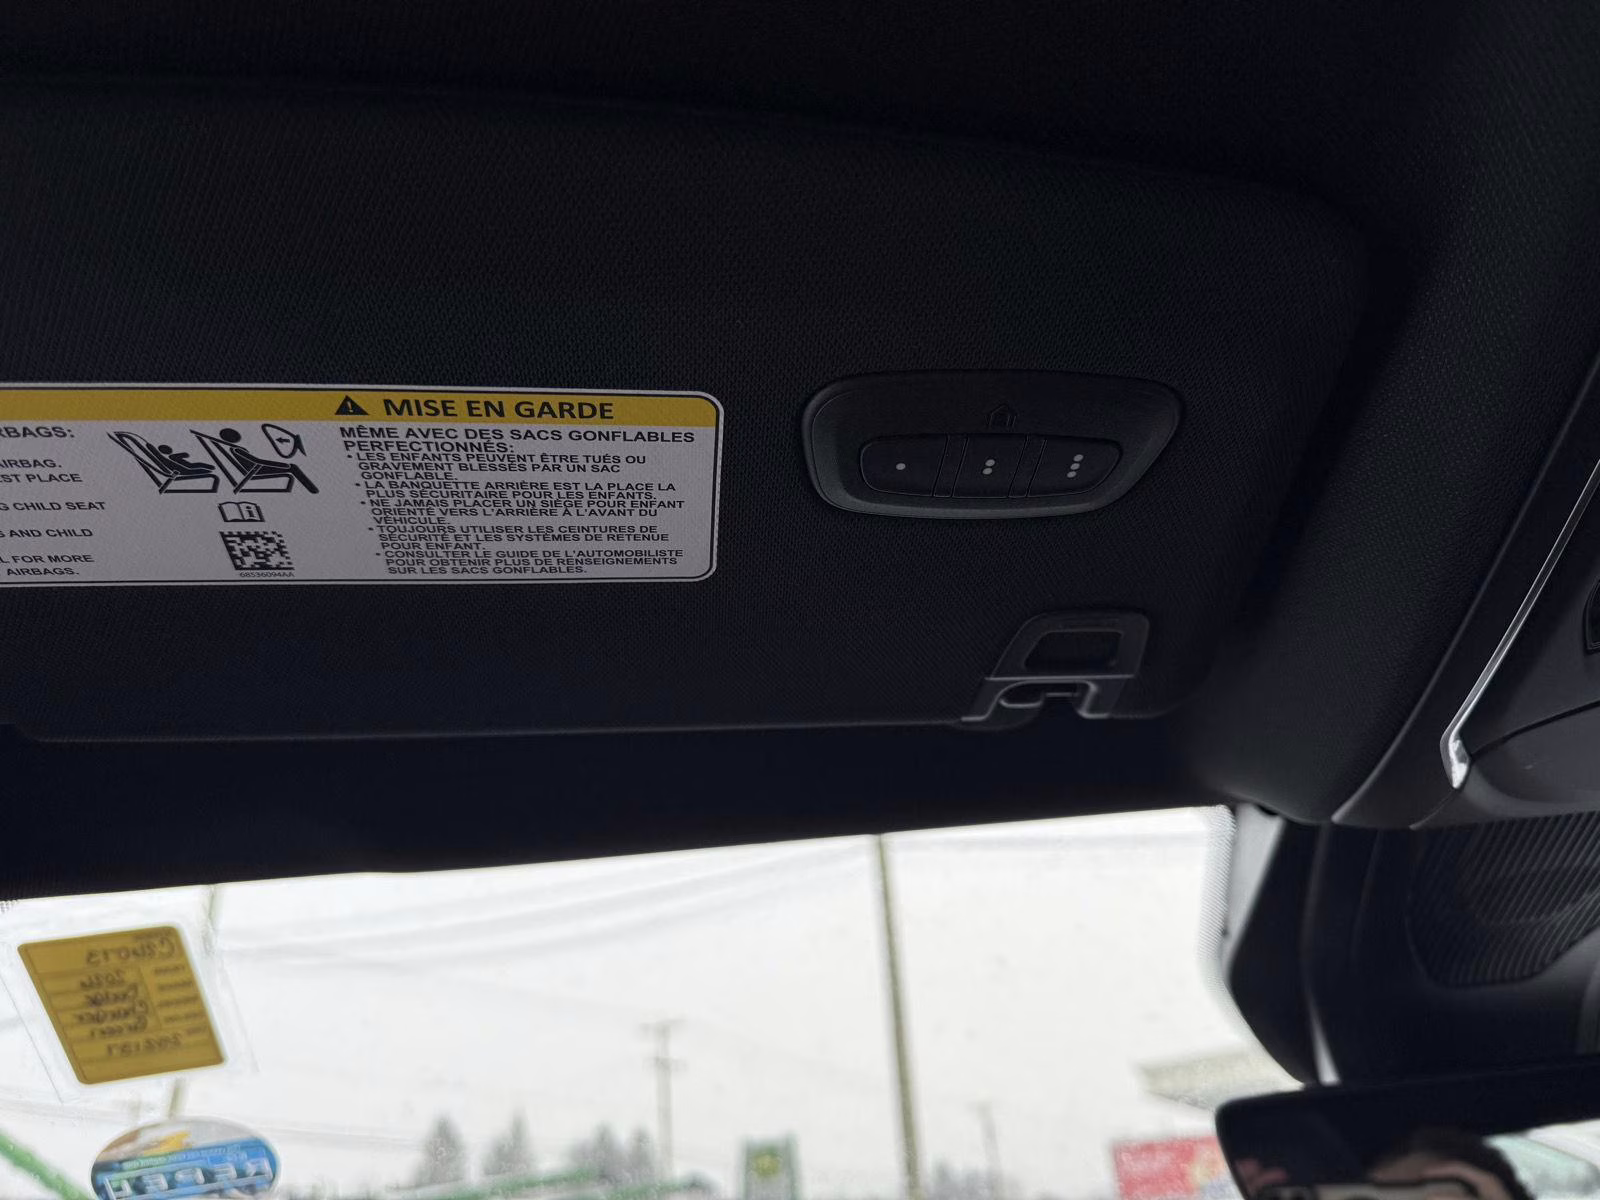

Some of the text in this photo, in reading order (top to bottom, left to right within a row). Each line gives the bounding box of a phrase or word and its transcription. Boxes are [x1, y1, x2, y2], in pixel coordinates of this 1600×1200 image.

[382, 399, 614, 420] MISE EN GARDE
[340, 425, 695, 443] MÊME AVEC DES SACS GONFLABLES
[344, 440, 515, 453] PERFECTIONNÉS:
[356, 452, 646, 464] LES ENFANTS PEUVENT ÊTRE TUÉS OU
[358, 461, 621, 473] GRAVEMENT BLESSÉS PAR UN SAC
[25, 473, 83, 483] PLACE
[361, 471, 459, 481] GONFLABLE.
[365, 480, 676, 491] LA BANQUETTE ARRIÈRE EST LA PLACE LA
[366, 489, 657, 500] PLUS SÉCURITAIRE POUR LES ENFANTS.
[12, 502, 62, 511] CHILD
[65, 501, 106, 510] SEAT
[370, 498, 685, 509] NE JAMAIS PLACER UN SIÈGE POUR ENFANT
[371, 506, 658, 517] ORIENTÉ VERS L'ARRIÈRE À L'AVANT DU
[373, 516, 451, 525] VÉHICULE.
[9, 529, 42, 538] AND
[45, 528, 93, 537] CHILD
[375, 525, 658, 534] TOUJOURS UTILISER LES CEINTURES DE
[378, 532, 670, 542] SÉCURITÉ ET LES SYSTÈMES DE RETENUE
[381, 542, 486, 550] POUR ENFANT.
[11, 555, 45, 564] FOR
[47, 554, 95, 563] MORE
[384, 549, 684, 559] CONSULTER LE GUIDE DE L'AUTOMOBILISTE
[385, 557, 678, 566] POUR OBTENIR PLUS DE RENSEIGNEMENTS
[6, 567, 80, 576] AIRBAGS.
[387, 566, 588, 575] SUR LES SACS GONFLABLES.
